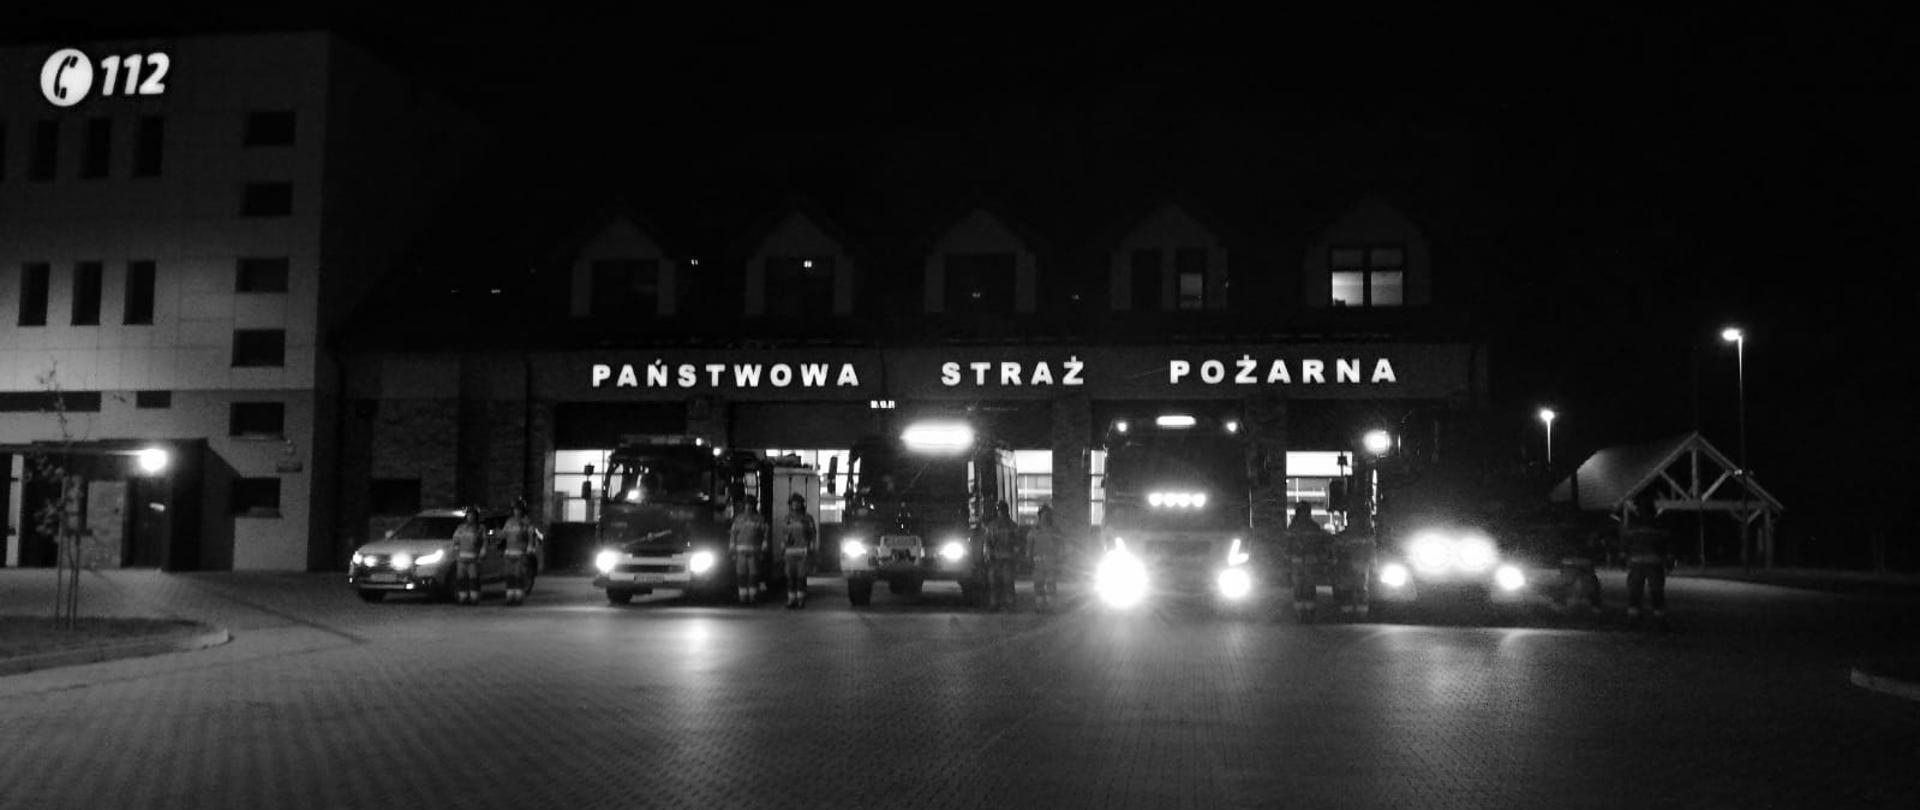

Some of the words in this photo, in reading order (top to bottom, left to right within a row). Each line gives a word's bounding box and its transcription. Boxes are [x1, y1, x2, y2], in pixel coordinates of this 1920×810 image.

[101, 52, 170, 96] 112
[592, 359, 859, 388] PAŃSTWOWA
[941, 355, 1084, 387] STRAŻ
[1169, 354, 1397, 385] POŻARNA
